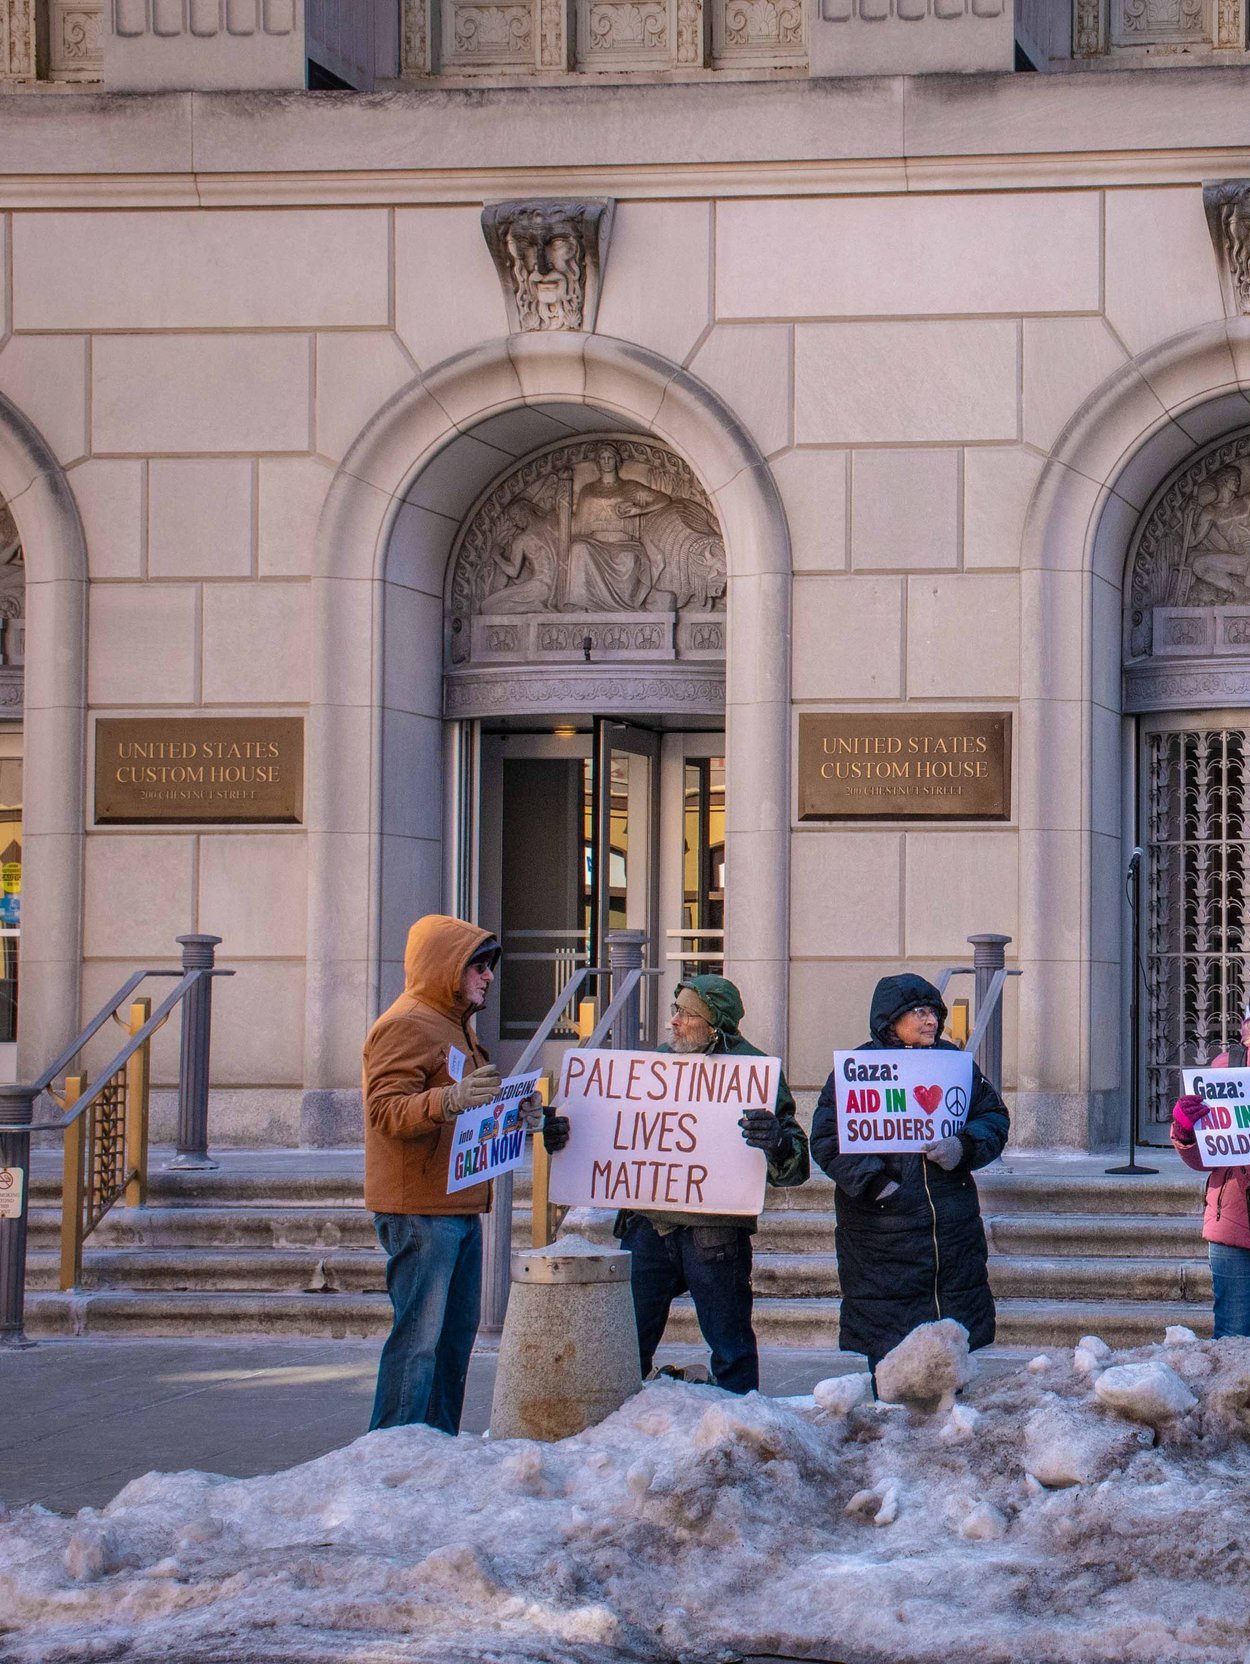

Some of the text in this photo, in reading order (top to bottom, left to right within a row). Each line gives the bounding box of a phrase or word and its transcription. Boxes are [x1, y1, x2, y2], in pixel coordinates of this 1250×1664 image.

[119, 742, 280, 759] UNITED STATES
[823, 736, 987, 754] UNITED STATES
[116, 766, 280, 783] CUSTOM HOUSE
[820, 761, 989, 779] CUSTOM HOUSE
[141, 790, 257, 800] 200 CHESTNUT STREET
[846, 786, 964, 796] 200 CHESTNUT STREET
[564, 1056, 770, 1104] PALESTINIAN
[843, 1057, 899, 1082] Gaza:
[1192, 1075, 1245, 1100] Gaza:
[845, 1088, 907, 1113] AID IN
[847, 1118, 935, 1142] SOLDIERS
[1200, 1106, 1232, 1130] AID
[458, 1129, 473, 1145] into
[613, 1110, 698, 1153] LIVES
[455, 1130, 524, 1181] GAZA NOW
[590, 1159, 708, 1204] MATTER
